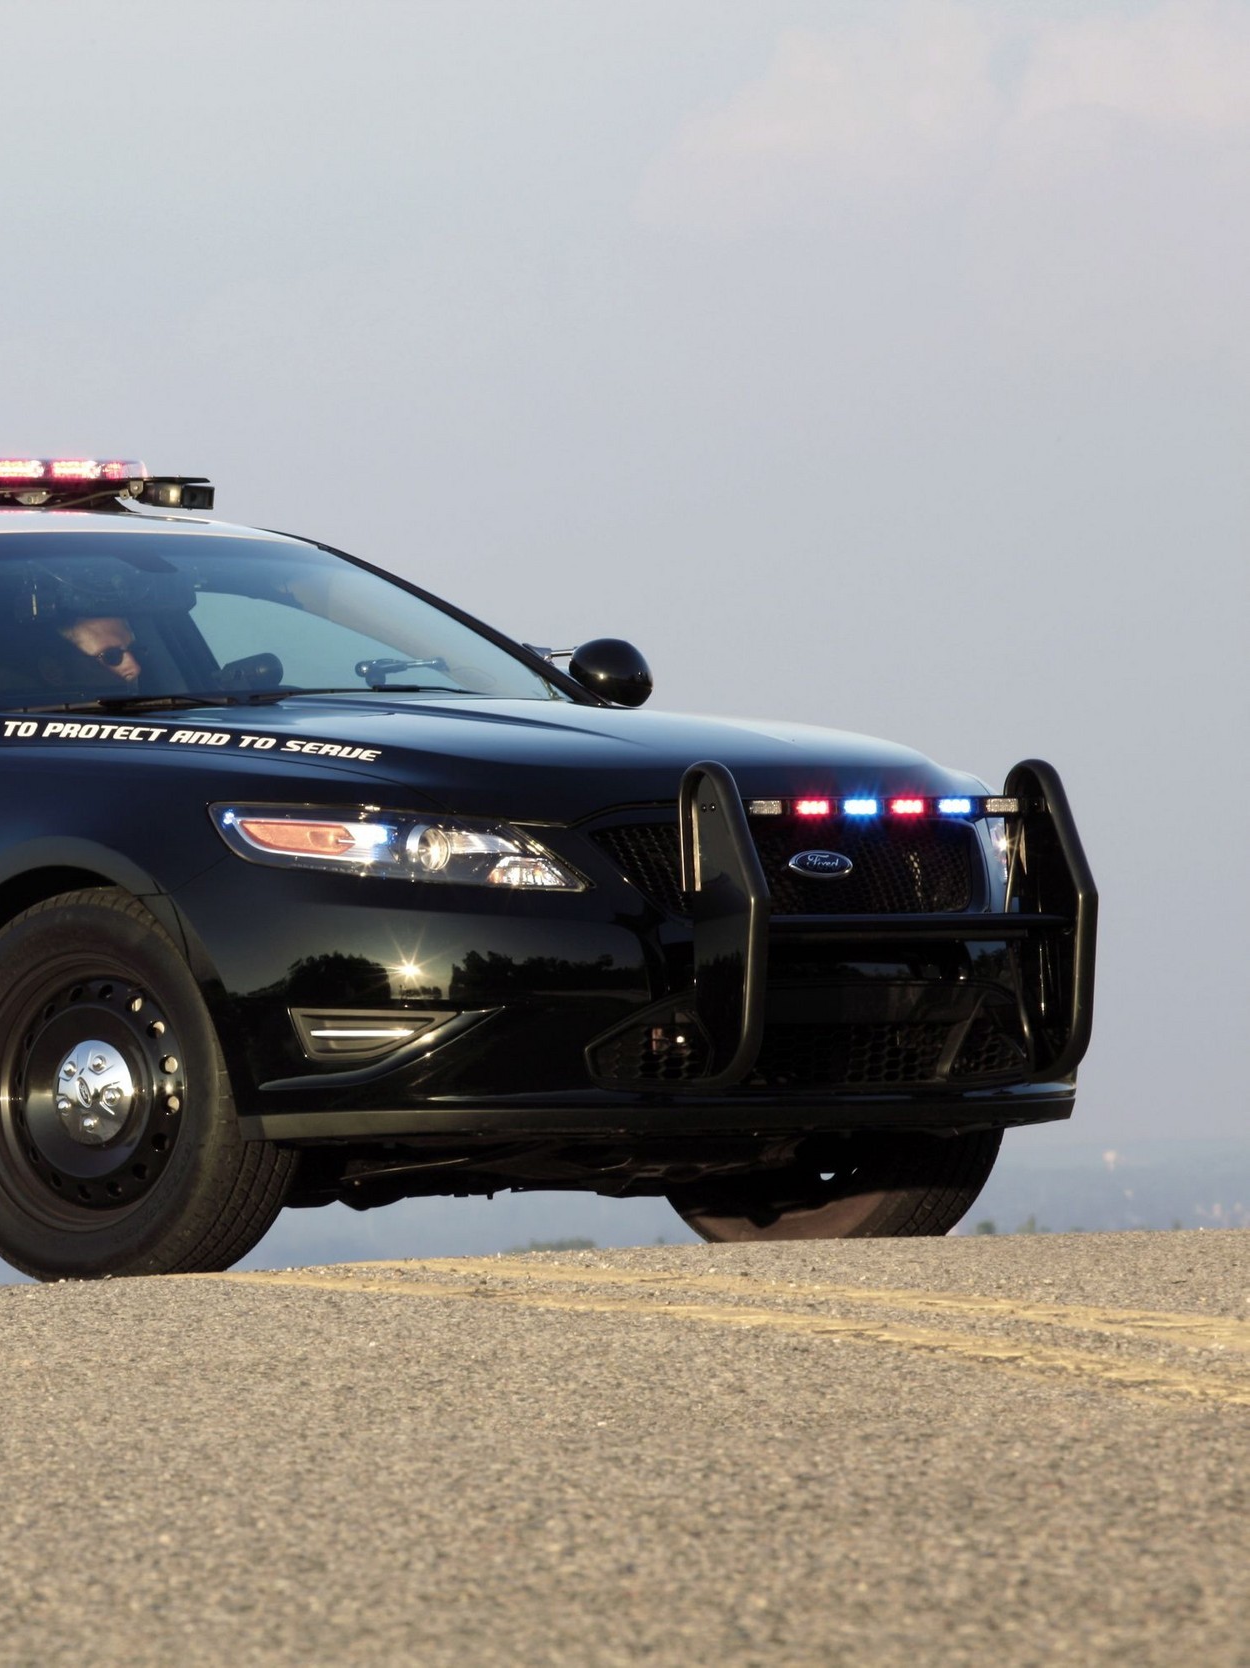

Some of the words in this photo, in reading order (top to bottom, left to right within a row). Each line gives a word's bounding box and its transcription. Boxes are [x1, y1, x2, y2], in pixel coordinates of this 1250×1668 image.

[3, 721, 38, 737] TO
[42, 722, 167, 742] PROTECT
[169, 729, 231, 746] AND
[239, 736, 278, 751] TO
[280, 740, 382, 762] SERVE
